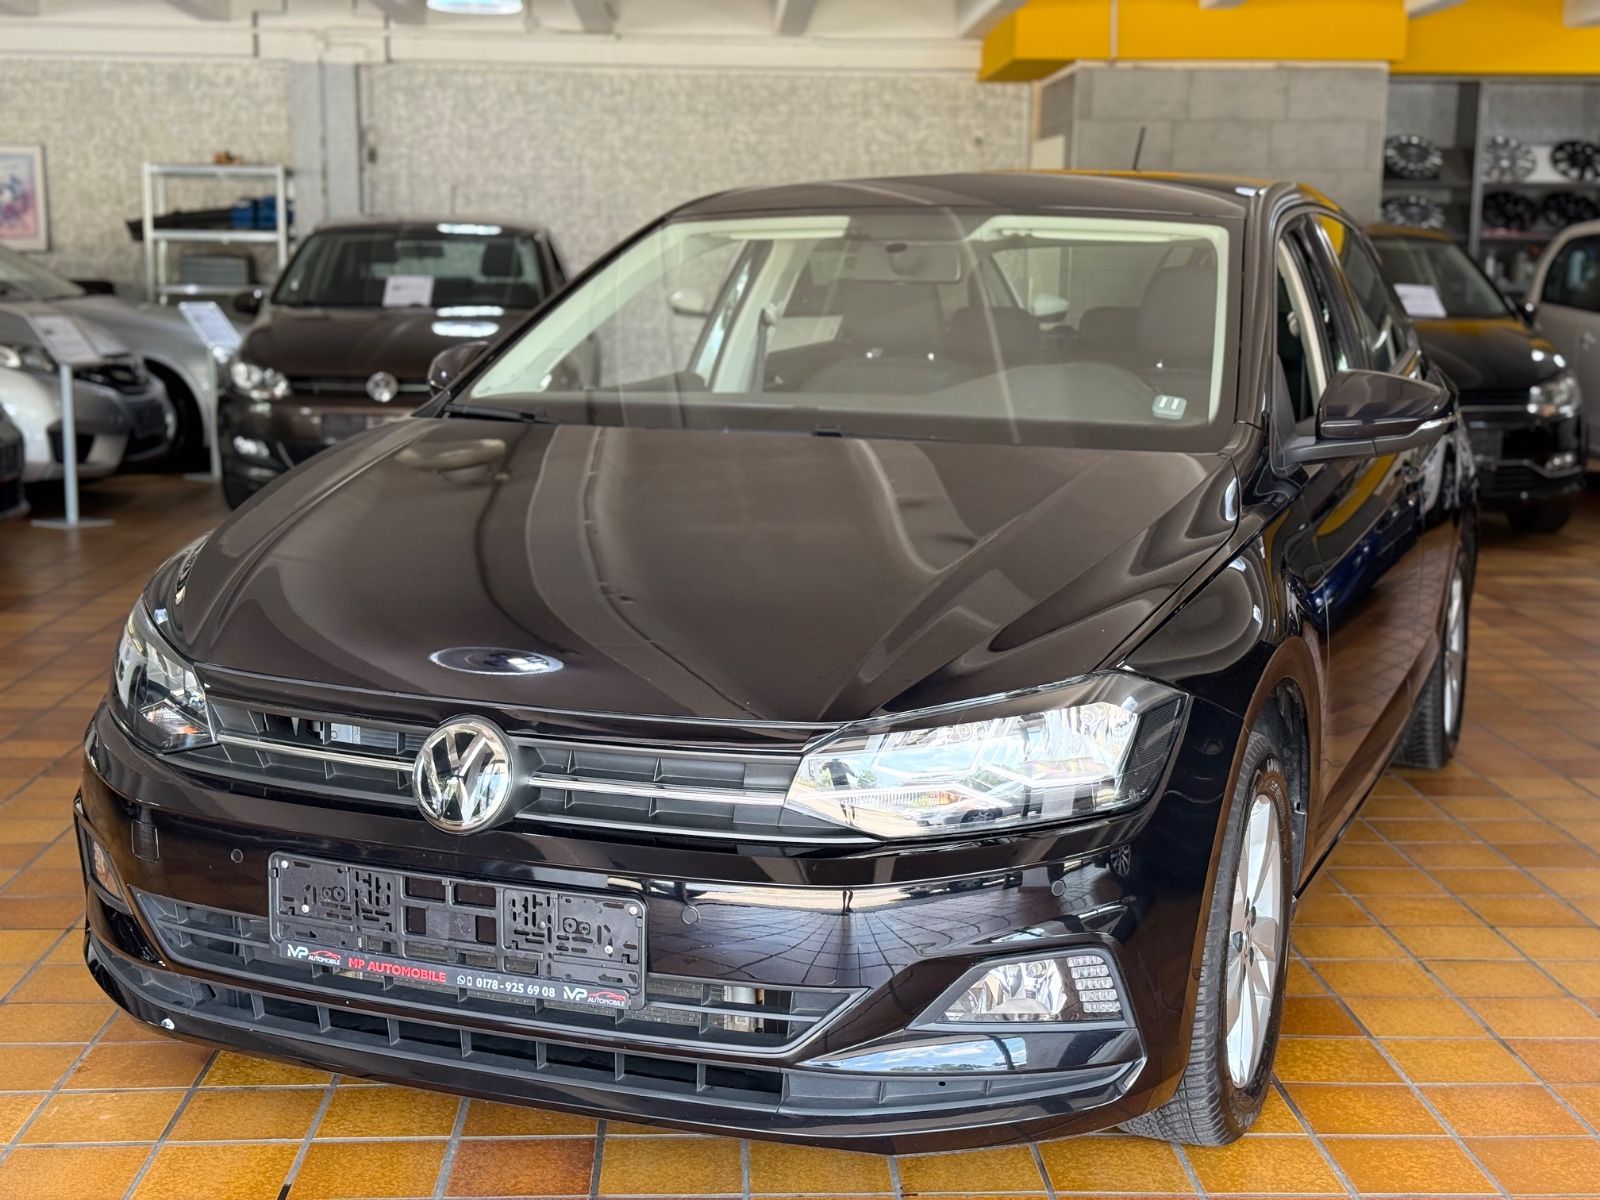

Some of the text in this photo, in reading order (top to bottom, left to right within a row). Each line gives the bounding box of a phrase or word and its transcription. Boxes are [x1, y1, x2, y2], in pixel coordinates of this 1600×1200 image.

[308, 956, 340, 966] AUTOMOBILE
[348, 957, 447, 982] MP AUTOMOBILE
[527, 984, 539, 996] 69
[541, 986, 556, 997] 08
[587, 997, 625, 1007] AUTOMOBILE
